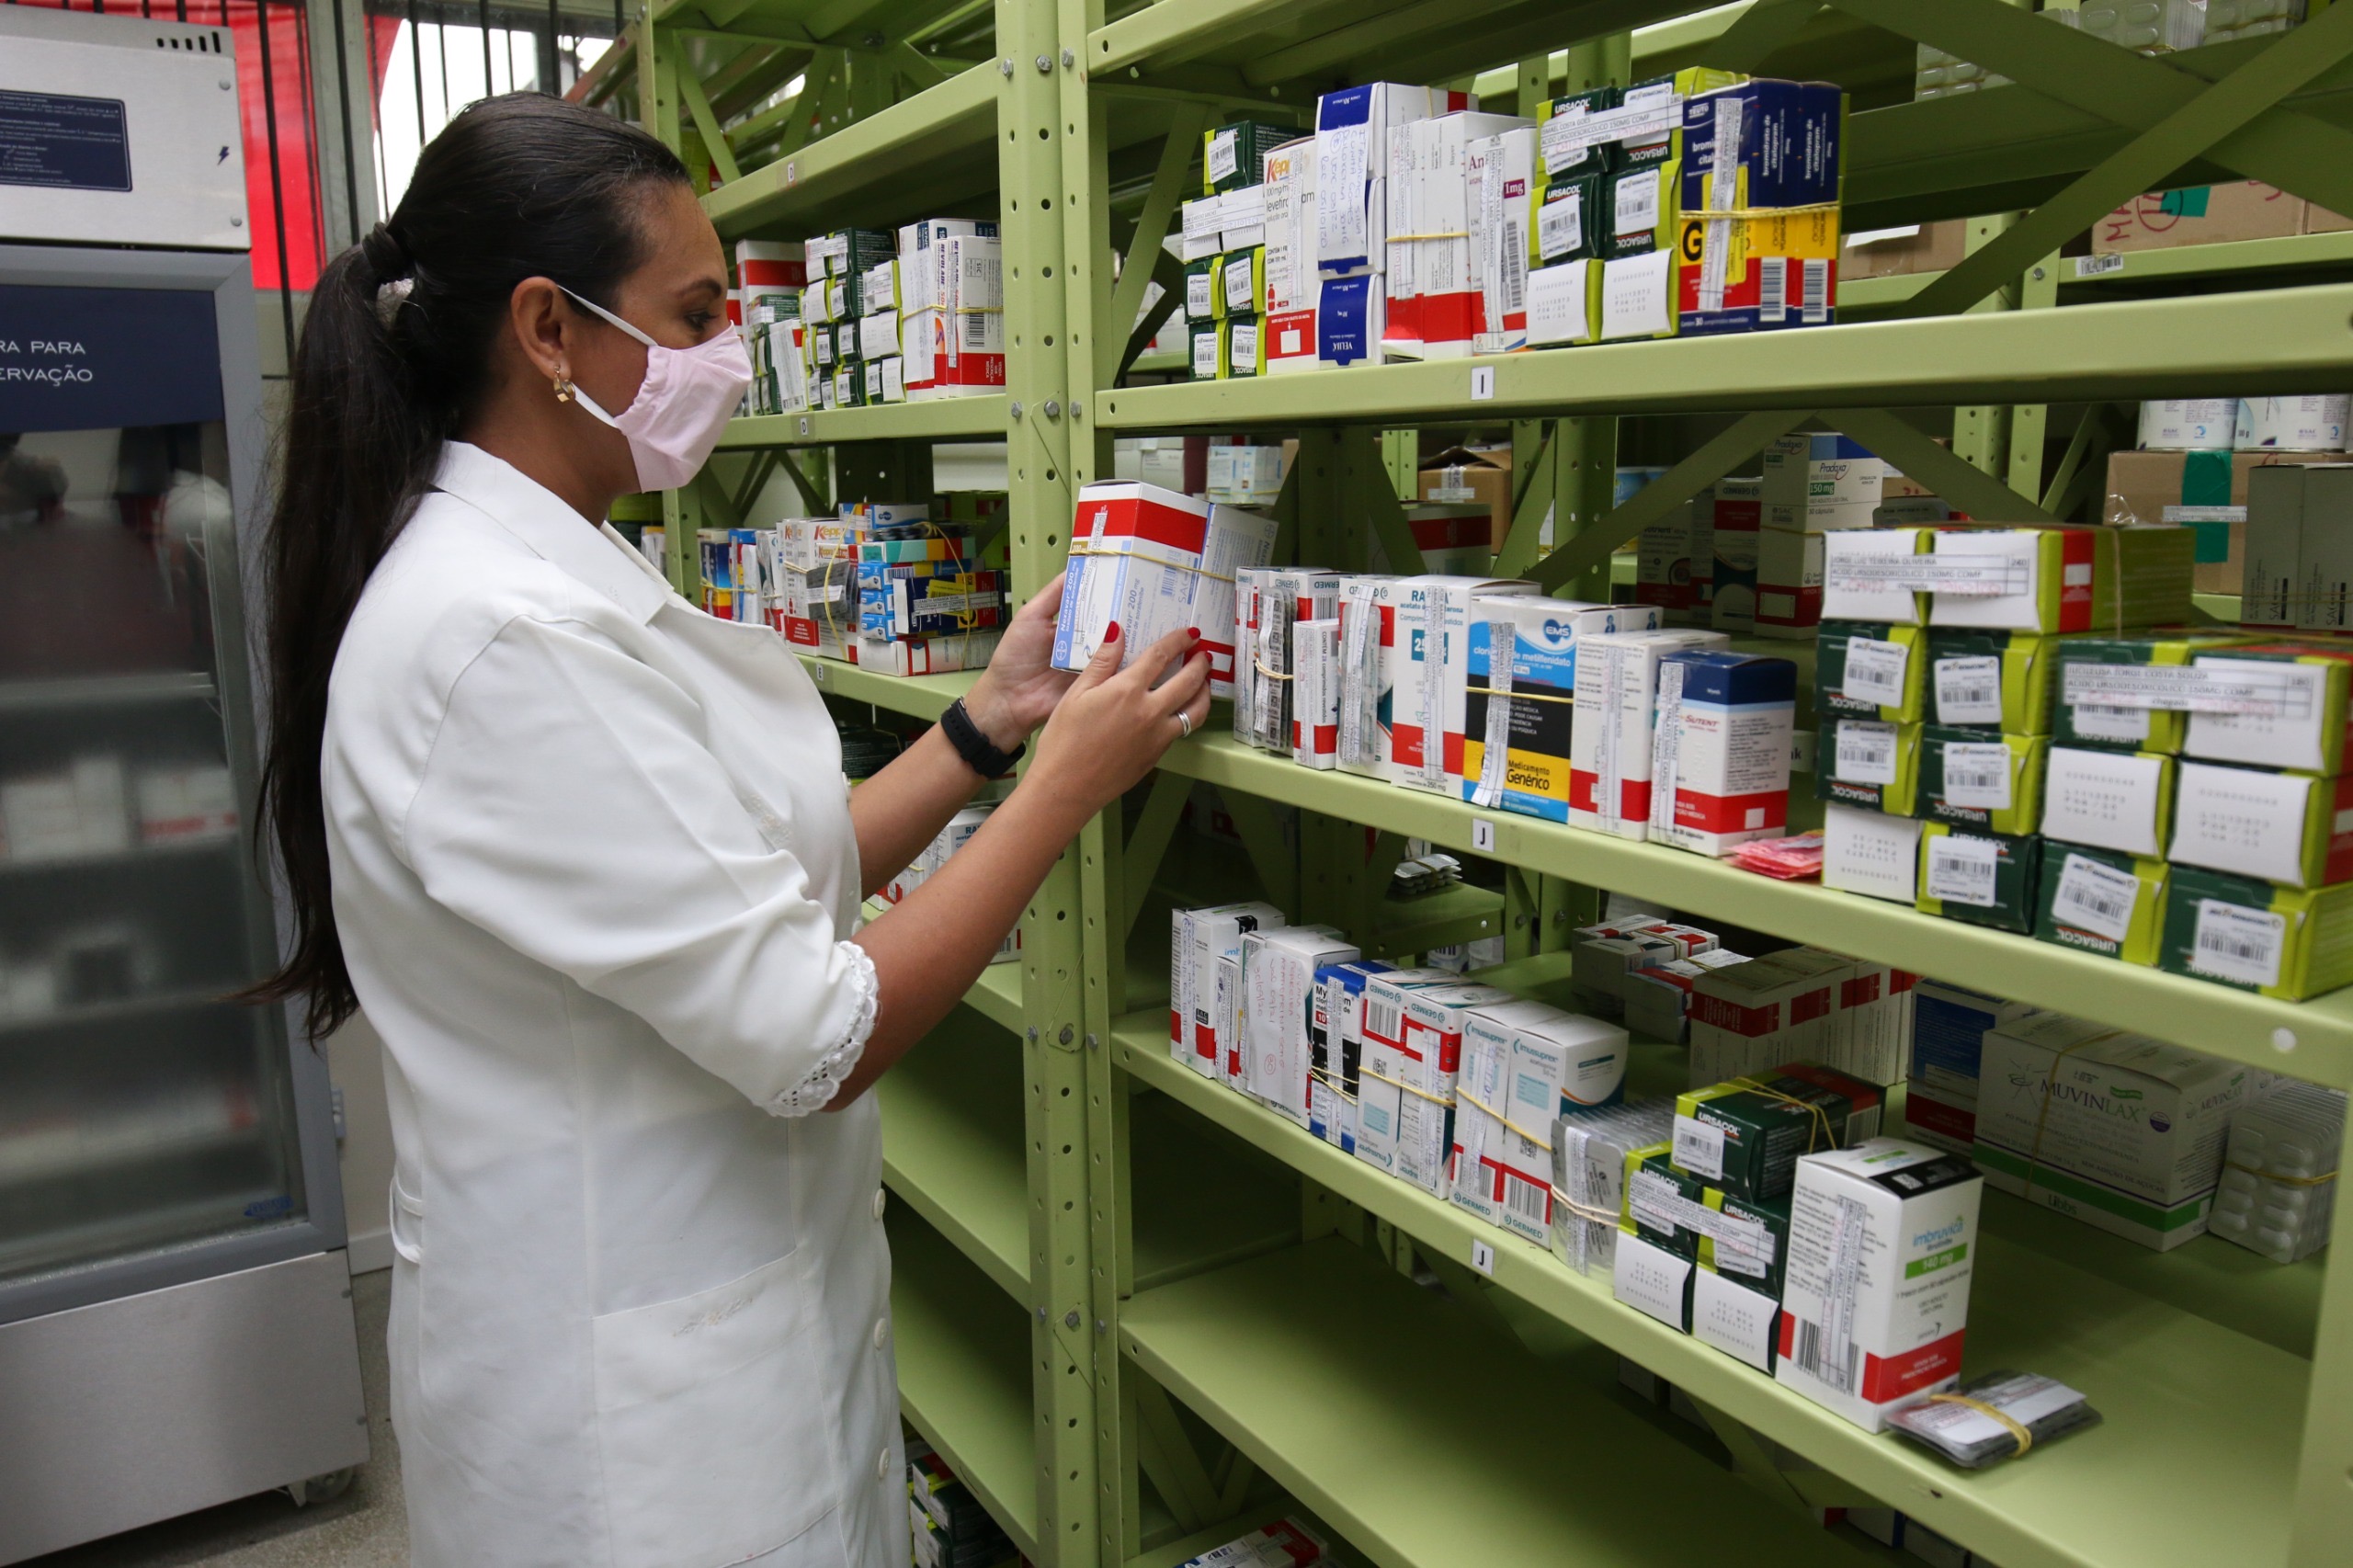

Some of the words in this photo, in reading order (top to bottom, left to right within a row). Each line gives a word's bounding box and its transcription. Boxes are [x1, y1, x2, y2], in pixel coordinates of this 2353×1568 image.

[1554, 97, 1591, 115] URSACOL
[1763, 115, 1770, 126] de
[1805, 119, 1813, 130] de
[1629, 146, 1668, 162] URSACOL
[1547, 185, 1582, 200] URSACOL
[1617, 233, 1652, 248] URSACOL
[1231, 301, 1252, 312] URSACOL
[30, 341, 86, 355] PARA
[1820, 462, 1847, 473] Pradaxa
[1810, 483, 1822, 494] 150
[1823, 484, 1835, 494] mg
[1815, 507, 1835, 516] cápsulas
[1275, 579, 1294, 588] GERMED
[1061, 592, 1073, 632] Nexavar
[1545, 627, 1570, 638] EMS
[1505, 640, 1513, 670] ANTONIO
[1523, 653, 1571, 667] metilfenidato
[2143, 670, 2174, 679] COSTA
[2177, 671, 2209, 680] SOUZA
[1685, 714, 1719, 727] SUTENT
[1508, 760, 1550, 776] Medicamento
[1427, 780, 1438, 790] 250
[1506, 771, 1550, 790] Genérico
[1831, 784, 1879, 804] URSACOL
[1932, 801, 1987, 824] URSACOL
[2056, 927, 2118, 953] URSACOL
[1370, 985, 1393, 999] GERMED
[1318, 1013, 1326, 1022] 10
[1411, 1003, 1437, 1020] GERMED
[1472, 1023, 1507, 1044] Imussuprex
[1519, 1040, 1558, 1062] Imussuprex
[2040, 1077, 2142, 1123] MUVINLAX
[1698, 1111, 1741, 1136] URSACOL
[1462, 1198, 1491, 1216] GERMED
[1699, 1203, 1721, 1221] SANTOS
[2048, 1195, 2078, 1216] Libbs
[1725, 1204, 1768, 1225] URSACOL
[1512, 1220, 1543, 1239] GERMED
[1913, 1219, 1965, 1247] imbruvica
[1939, 1252, 1953, 1265] mg
